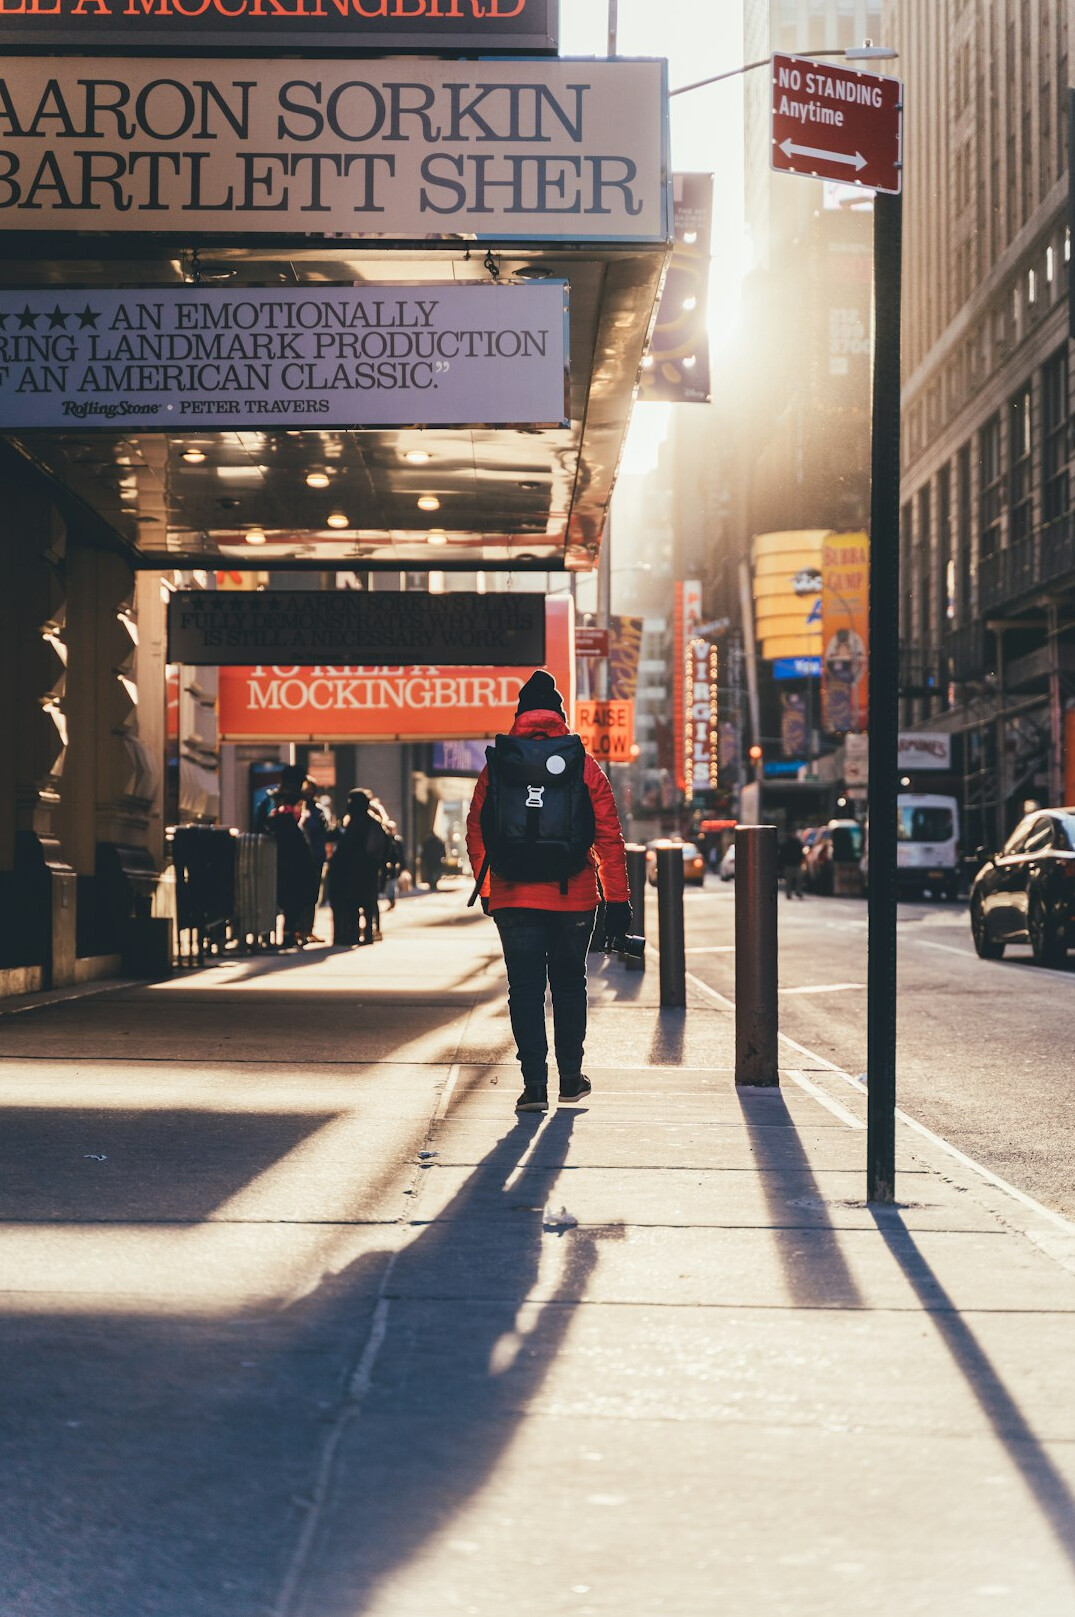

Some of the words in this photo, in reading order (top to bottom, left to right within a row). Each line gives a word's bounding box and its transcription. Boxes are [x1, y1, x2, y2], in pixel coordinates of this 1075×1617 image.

[778, 66, 801, 91] NO
[805, 72, 883, 108] STANDING
[277, 80, 591, 143] SORKIN
[778, 95, 844, 127] Anytime
[419, 153, 643, 216] SHER
[108, 303, 164, 331] AN
[174, 301, 439, 330] EMOTIONALLY
[88, 332, 305, 361] LANDMARK
[313, 329, 549, 359] PRODUCTION
[15, 366, 69, 393] AN
[76, 364, 273, 392] AMERICAN
[179, 400, 241, 414] PETER
[245, 399, 330, 414] TRAVERS
[181, 612, 247, 630] FULLY
[252, 612, 424, 630] DEMONSTRATES
[429, 613, 480, 630] WHY
[480, 613, 533, 630] THIS
[203, 630, 223, 647] IS
[227, 630, 287, 647] STILL
[290, 630, 308, 647] A
[311, 630, 434, 647] NECESSARY
[246, 677, 526, 710] MOCKINGBIRD
[580, 709, 627, 727] RAISE
